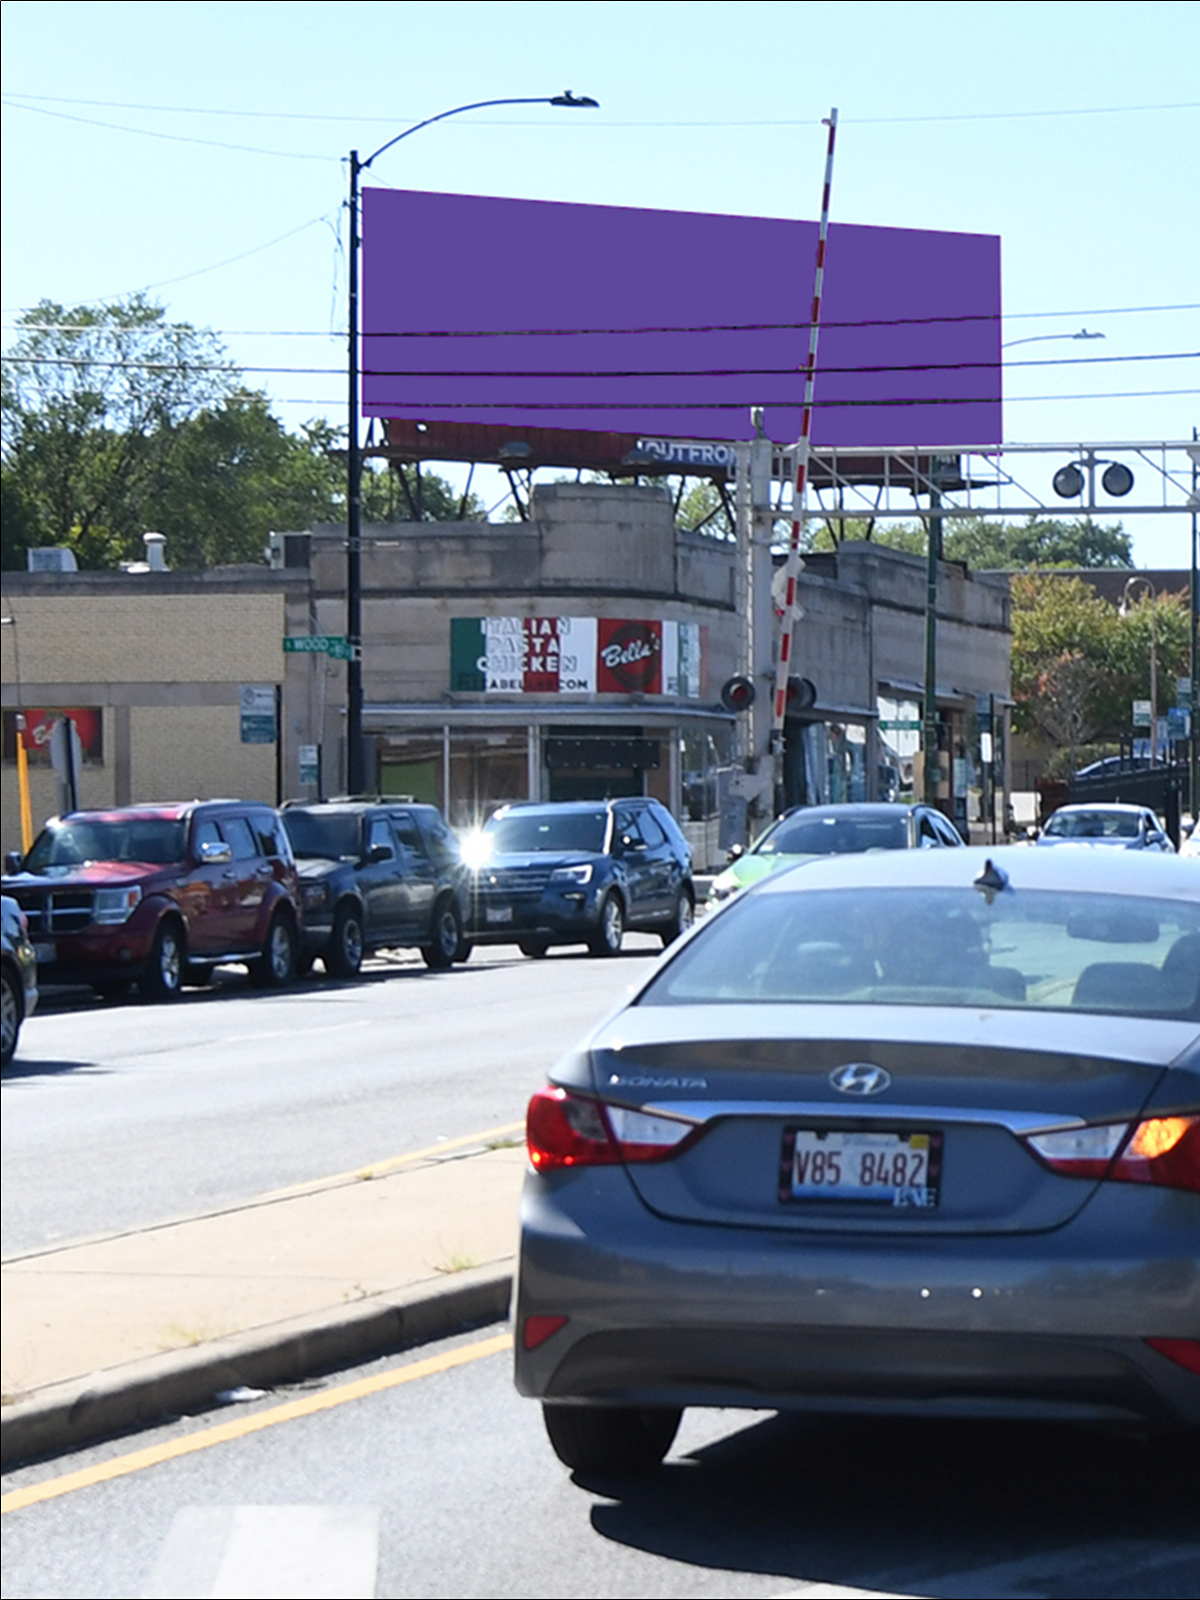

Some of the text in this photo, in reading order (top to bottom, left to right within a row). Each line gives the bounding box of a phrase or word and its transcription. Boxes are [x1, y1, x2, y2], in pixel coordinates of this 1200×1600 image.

[645, 441, 739, 463] OUTFRON
[480, 617, 571, 635] ITALIAN
[294, 638, 329, 651] WOOD
[488, 637, 561, 653] PASTA
[601, 632, 661, 667] Bella's
[476, 656, 578, 672] CHICKEN
[795, 1151, 925, 1187] V85 8482
